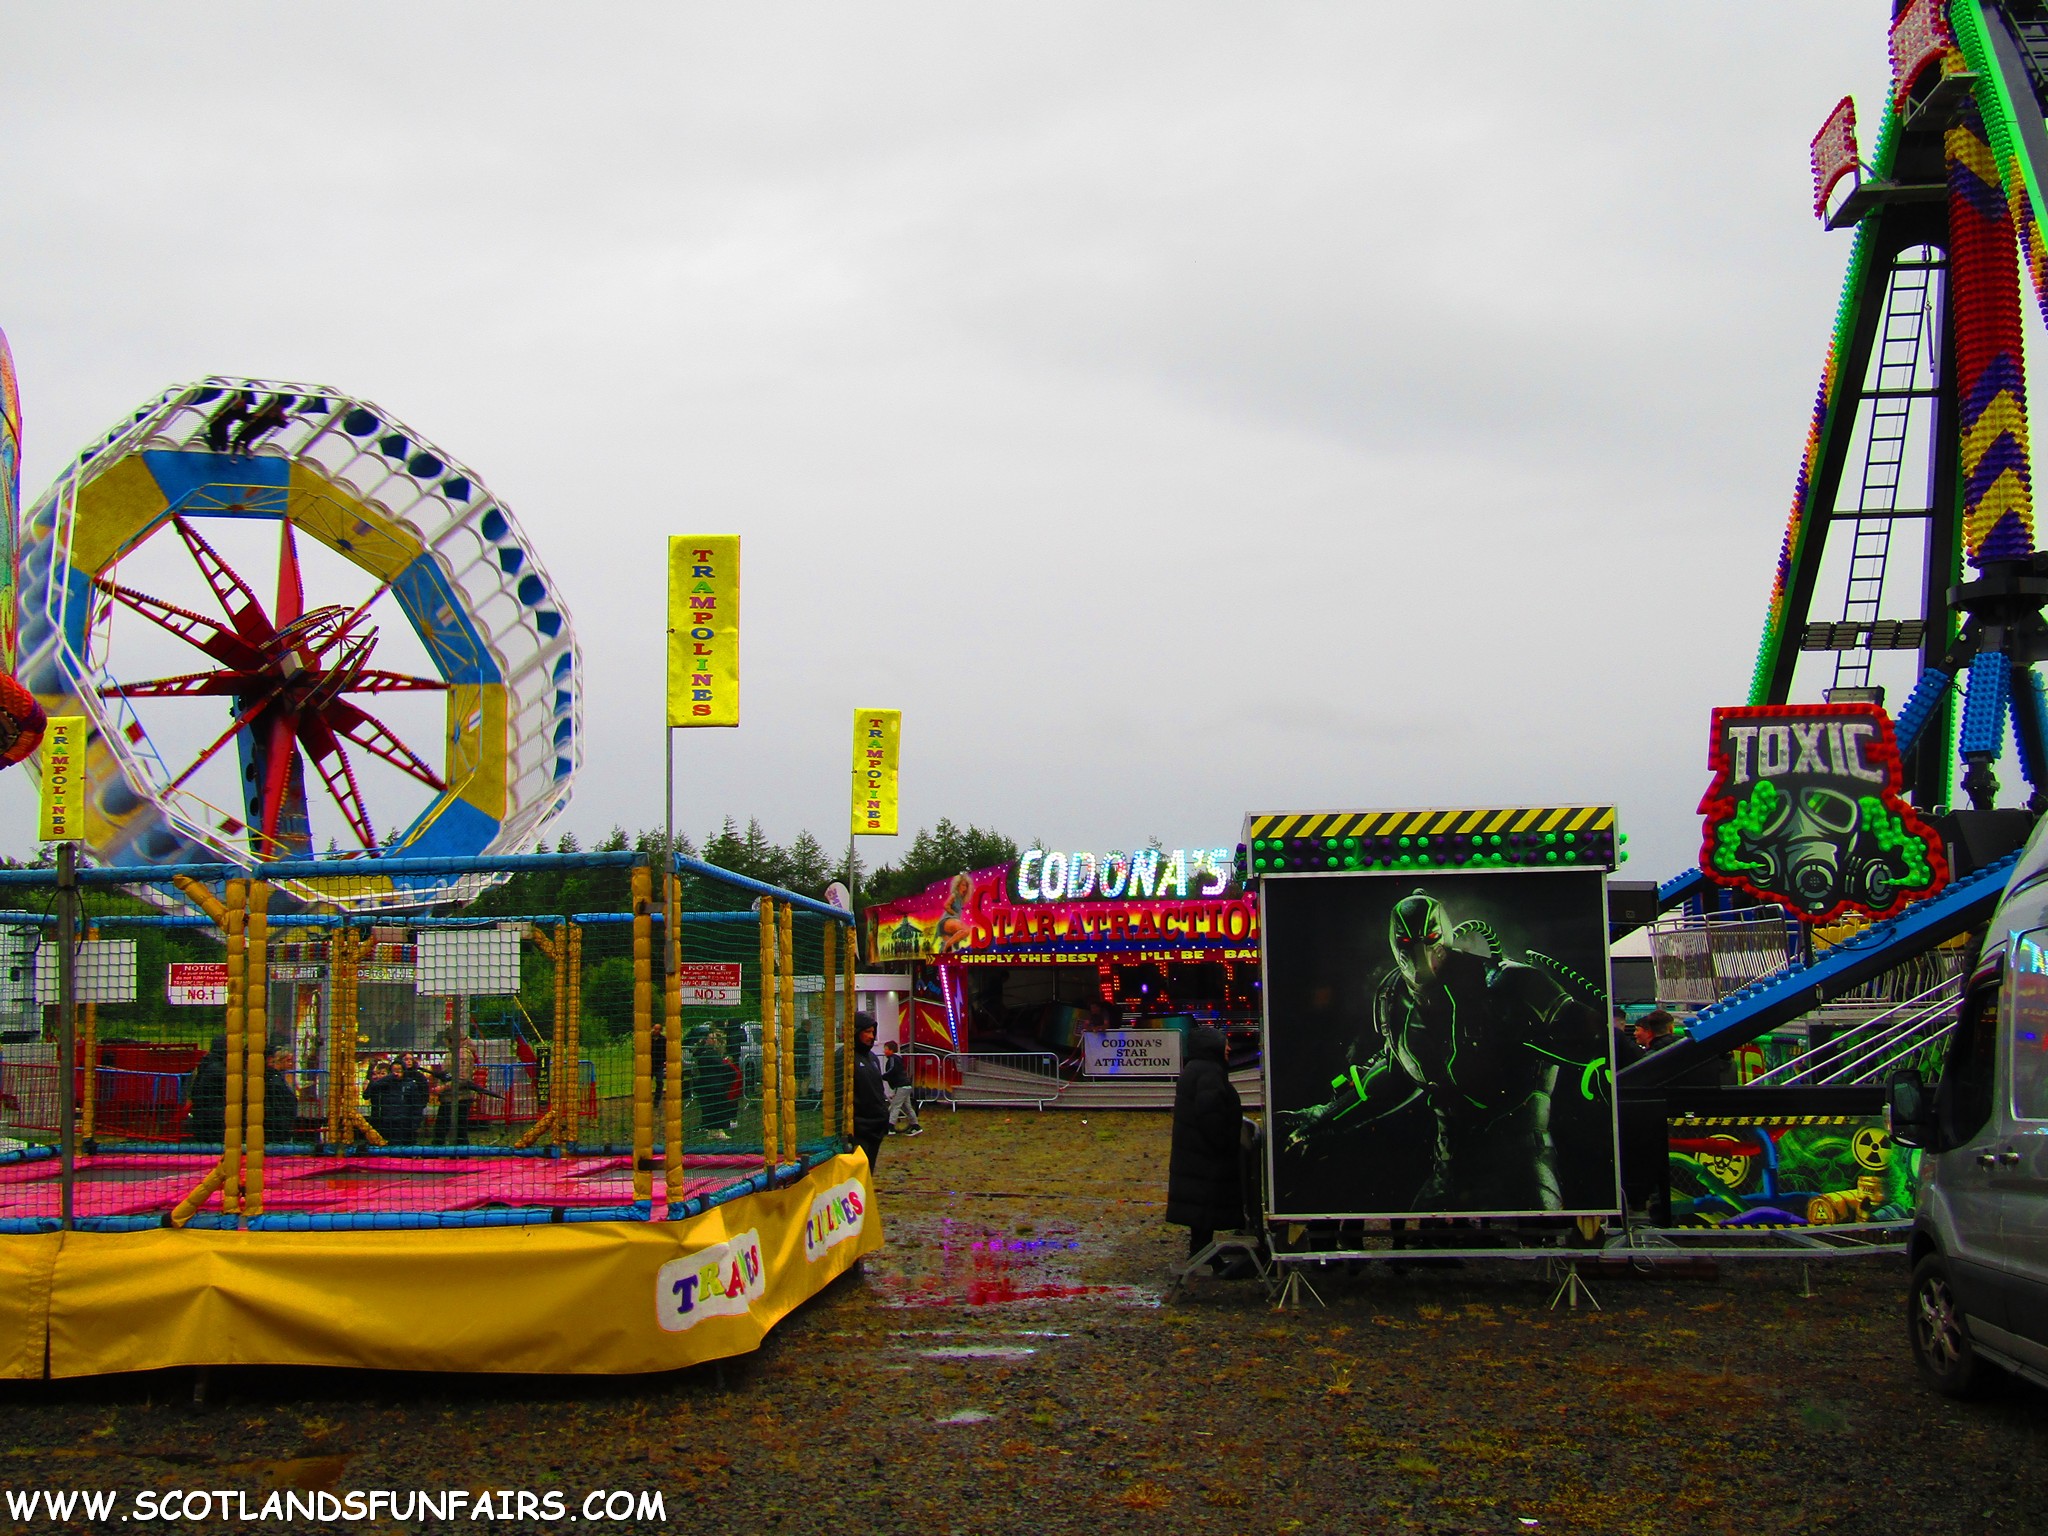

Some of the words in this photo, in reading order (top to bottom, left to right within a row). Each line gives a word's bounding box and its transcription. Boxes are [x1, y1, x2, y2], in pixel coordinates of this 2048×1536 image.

[689, 550, 717, 716] TRAMPOLINES
[1728, 722, 1884, 785] TOXIC
[866, 719, 884, 828] TRAMPOLINES
[51, 726, 70, 835] TRAMPOLINES
[1017, 849, 1229, 900] CODONA'S
[971, 876, 1056, 949] STAR
[1063, 901, 1259, 943] ATRACTIO
[960, 954, 1015, 964] SIMPLY
[1019, 954, 1050, 963] THE
[1056, 953, 1098, 963] BEST
[1140, 951, 1174, 961] I'LL
[1181, 951, 1205, 960] BE
[187, 989, 215, 1000] NO.1
[694, 989, 726, 1000] NO.5
[1101, 1039, 1162, 1048] CODONA'S
[1116, 1049, 1148, 1057] STAR
[1094, 1058, 1171, 1067] ATTRACTION
